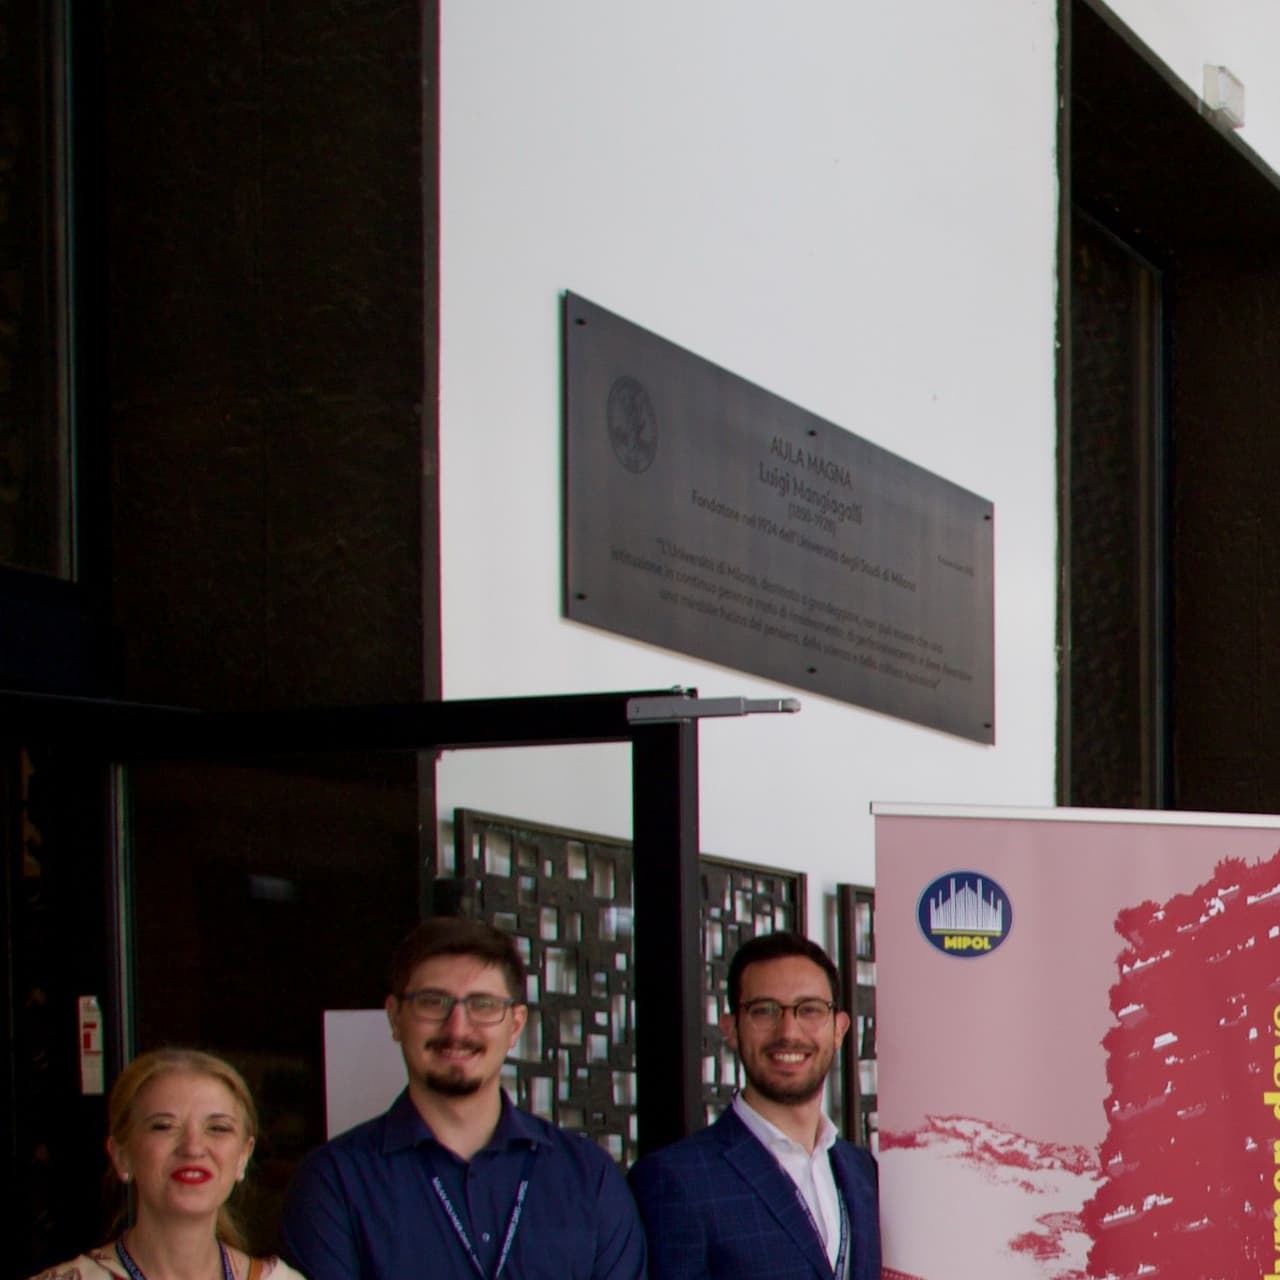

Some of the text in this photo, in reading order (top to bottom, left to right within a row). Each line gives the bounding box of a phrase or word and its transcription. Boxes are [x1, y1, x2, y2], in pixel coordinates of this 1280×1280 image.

[770, 437, 851, 487] AULA MAGNA
[759, 464, 863, 526] Luigi Mangiagalli
[944, 936, 992, 951] MIPOL
